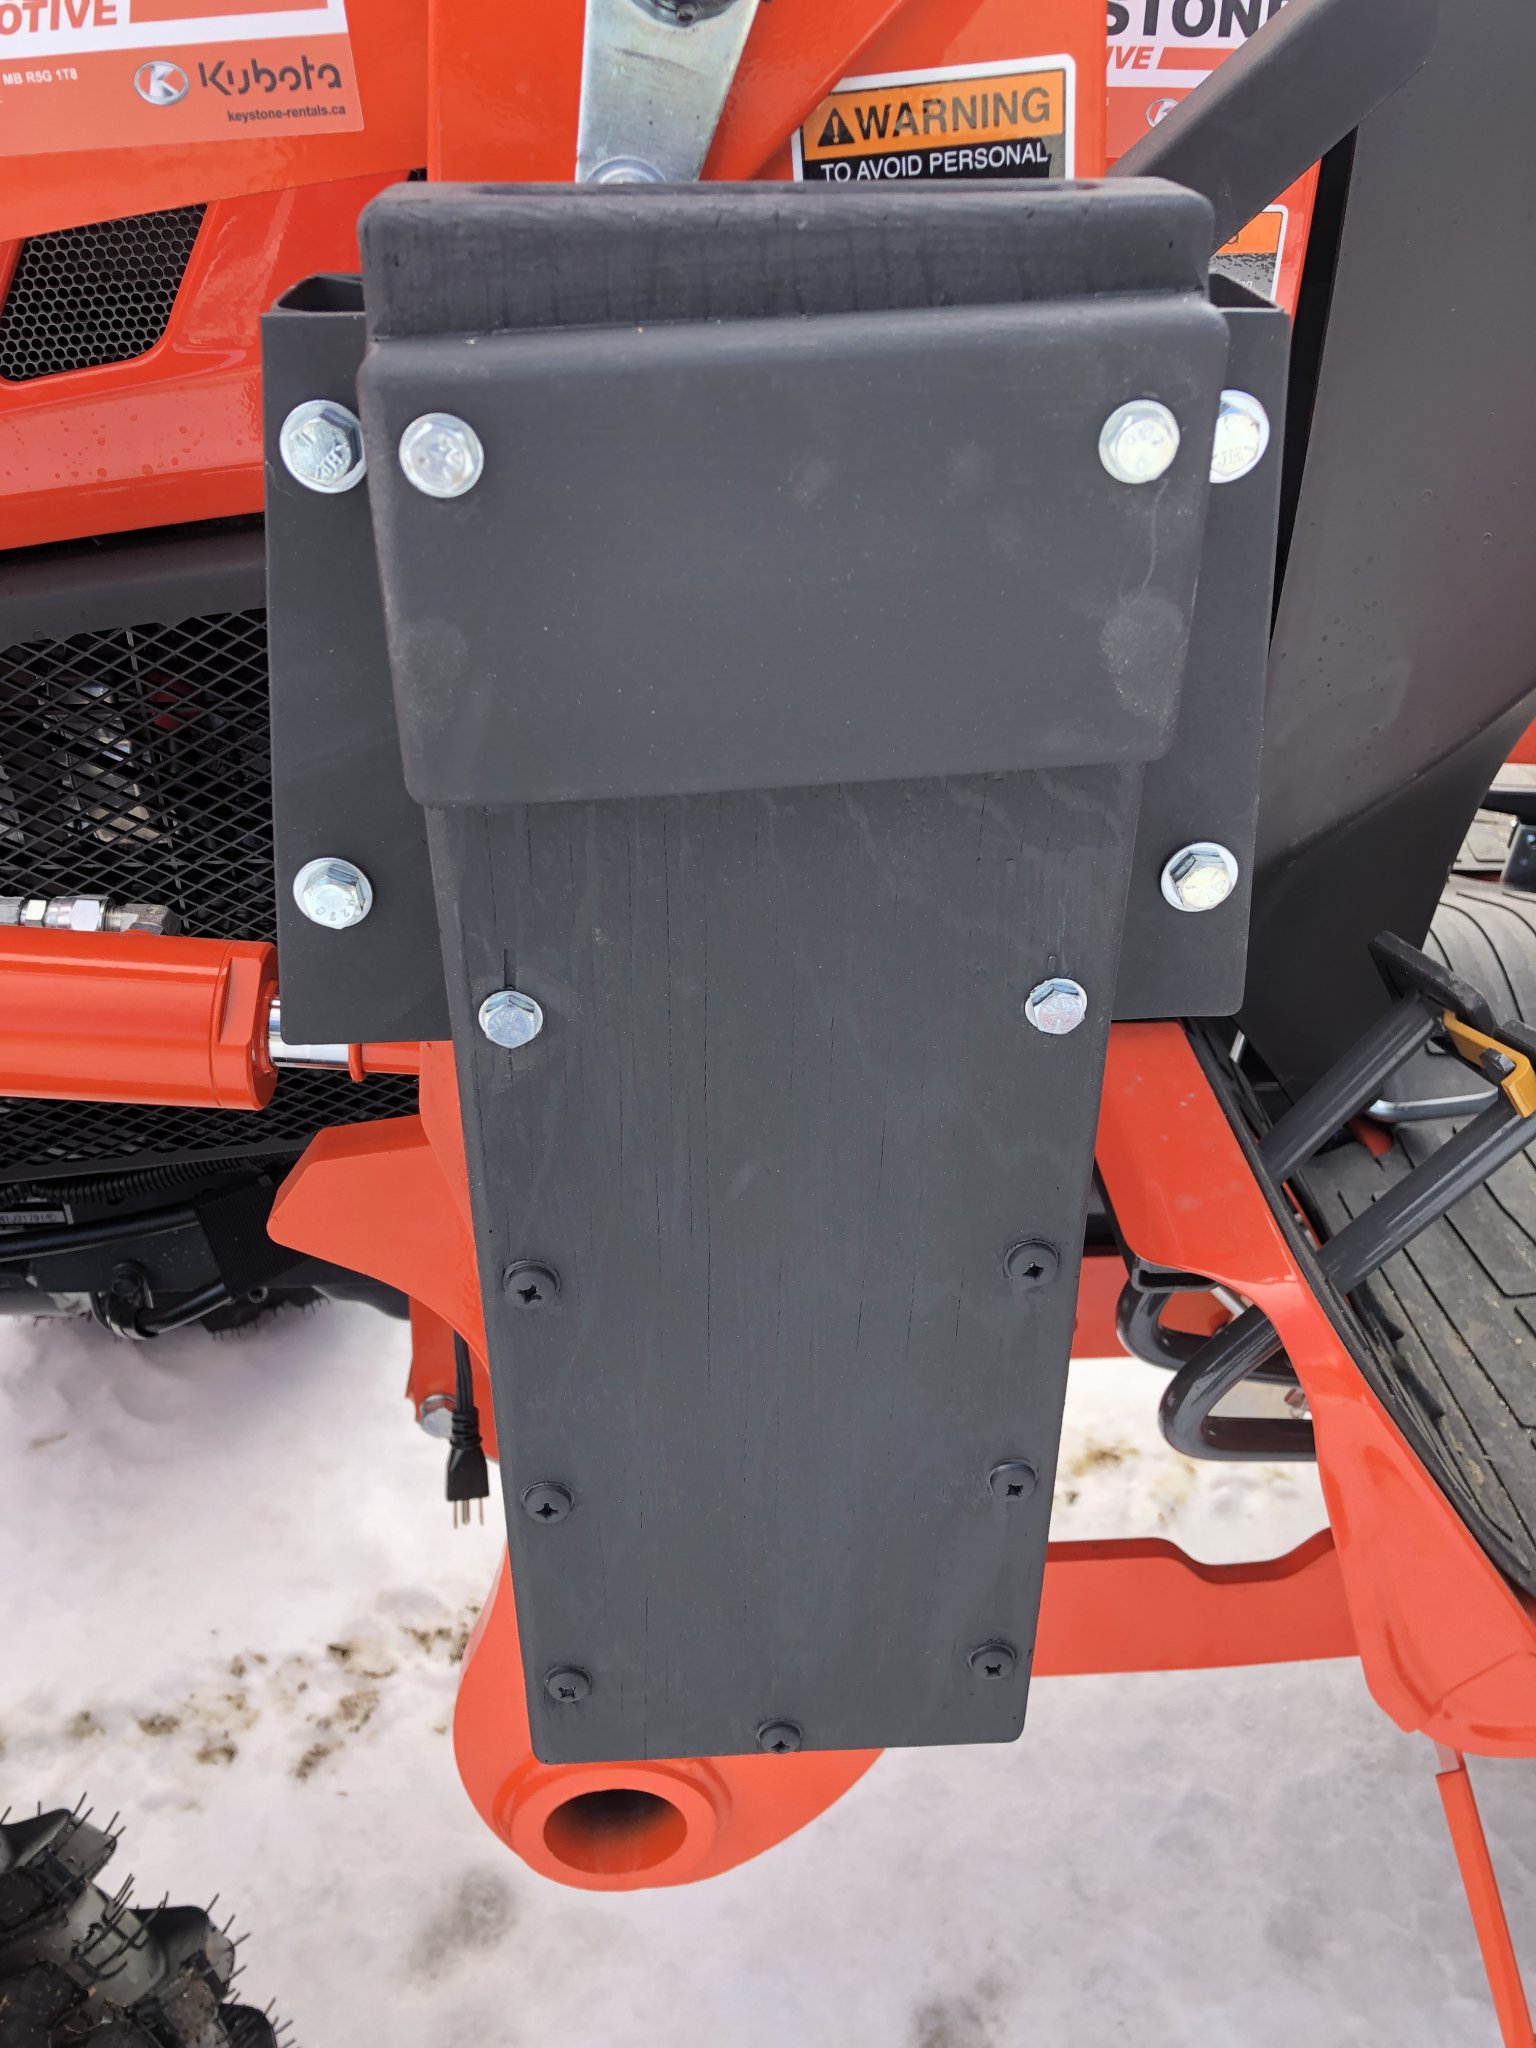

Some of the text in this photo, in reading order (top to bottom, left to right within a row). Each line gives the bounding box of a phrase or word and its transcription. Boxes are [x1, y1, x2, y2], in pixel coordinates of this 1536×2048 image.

[1106, 0, 1286, 38] STON
[2, 68, 78, 86] MB R5G 1T8
[199, 55, 342, 96] Kubota
[227, 105, 346, 122] keystone-rentals.ca
[854, 86, 1050, 141] WARNING
[821, 142, 1048, 182] TO AVOID PERSONAL
